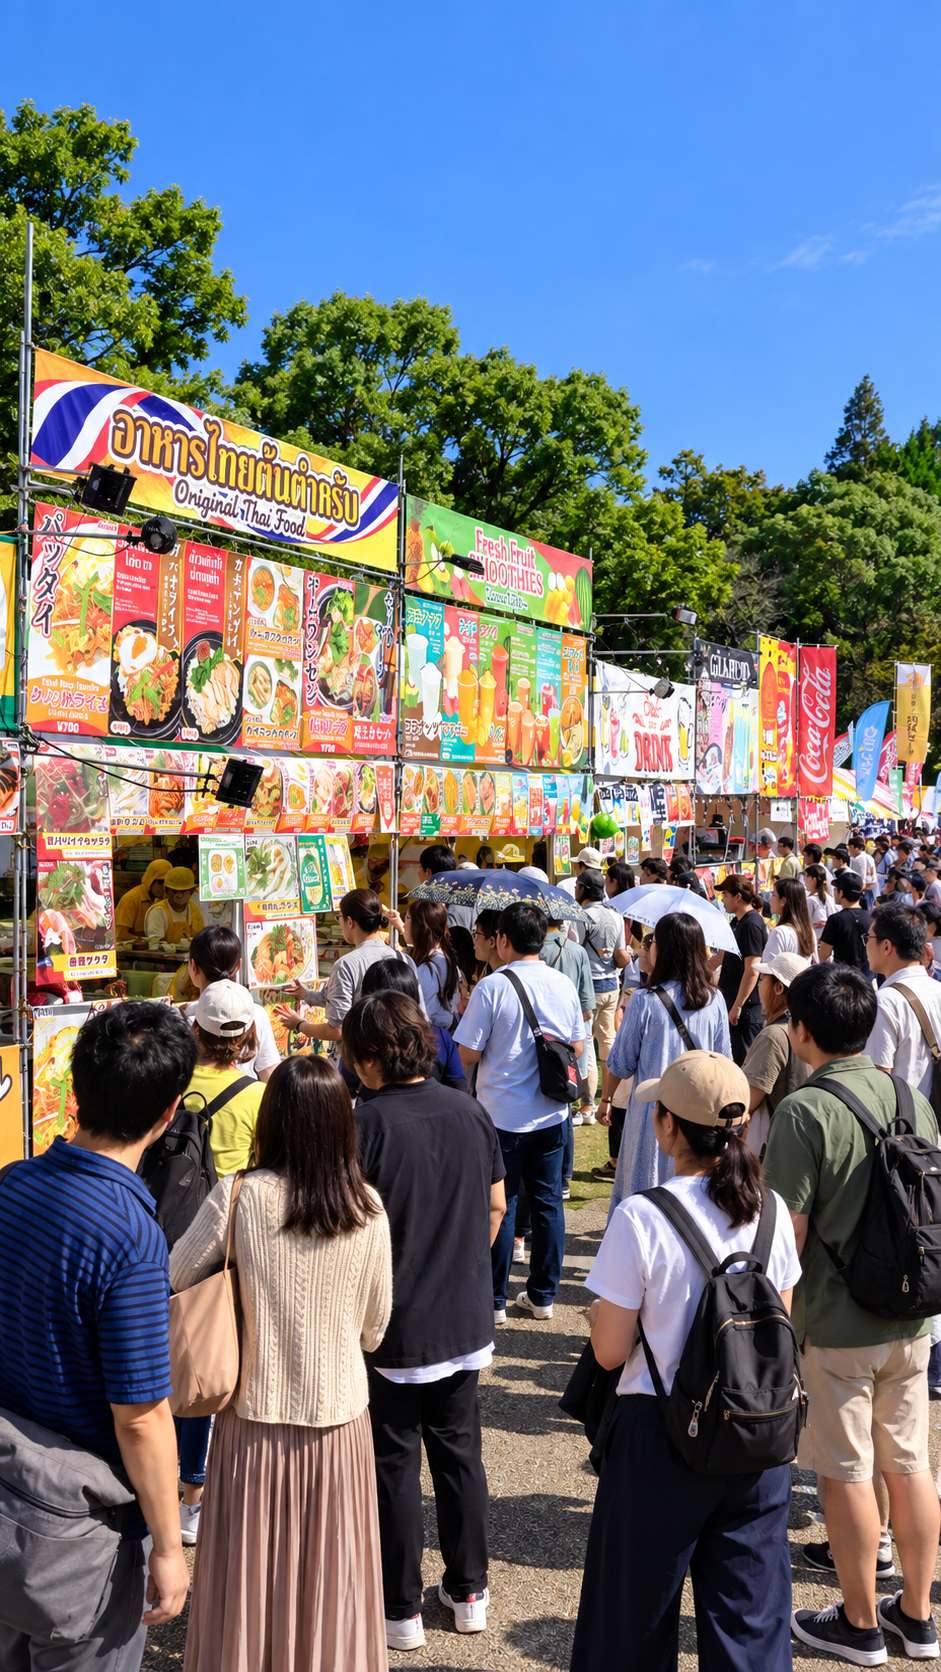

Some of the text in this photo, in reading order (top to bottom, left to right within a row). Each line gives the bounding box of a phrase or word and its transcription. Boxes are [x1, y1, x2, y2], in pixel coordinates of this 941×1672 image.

[242, 498, 273, 529] Thai
[273, 509, 306, 538] Food
[475, 527, 536, 570] Fresh Fruit
[799, 653, 832, 784] Coca-Cola
